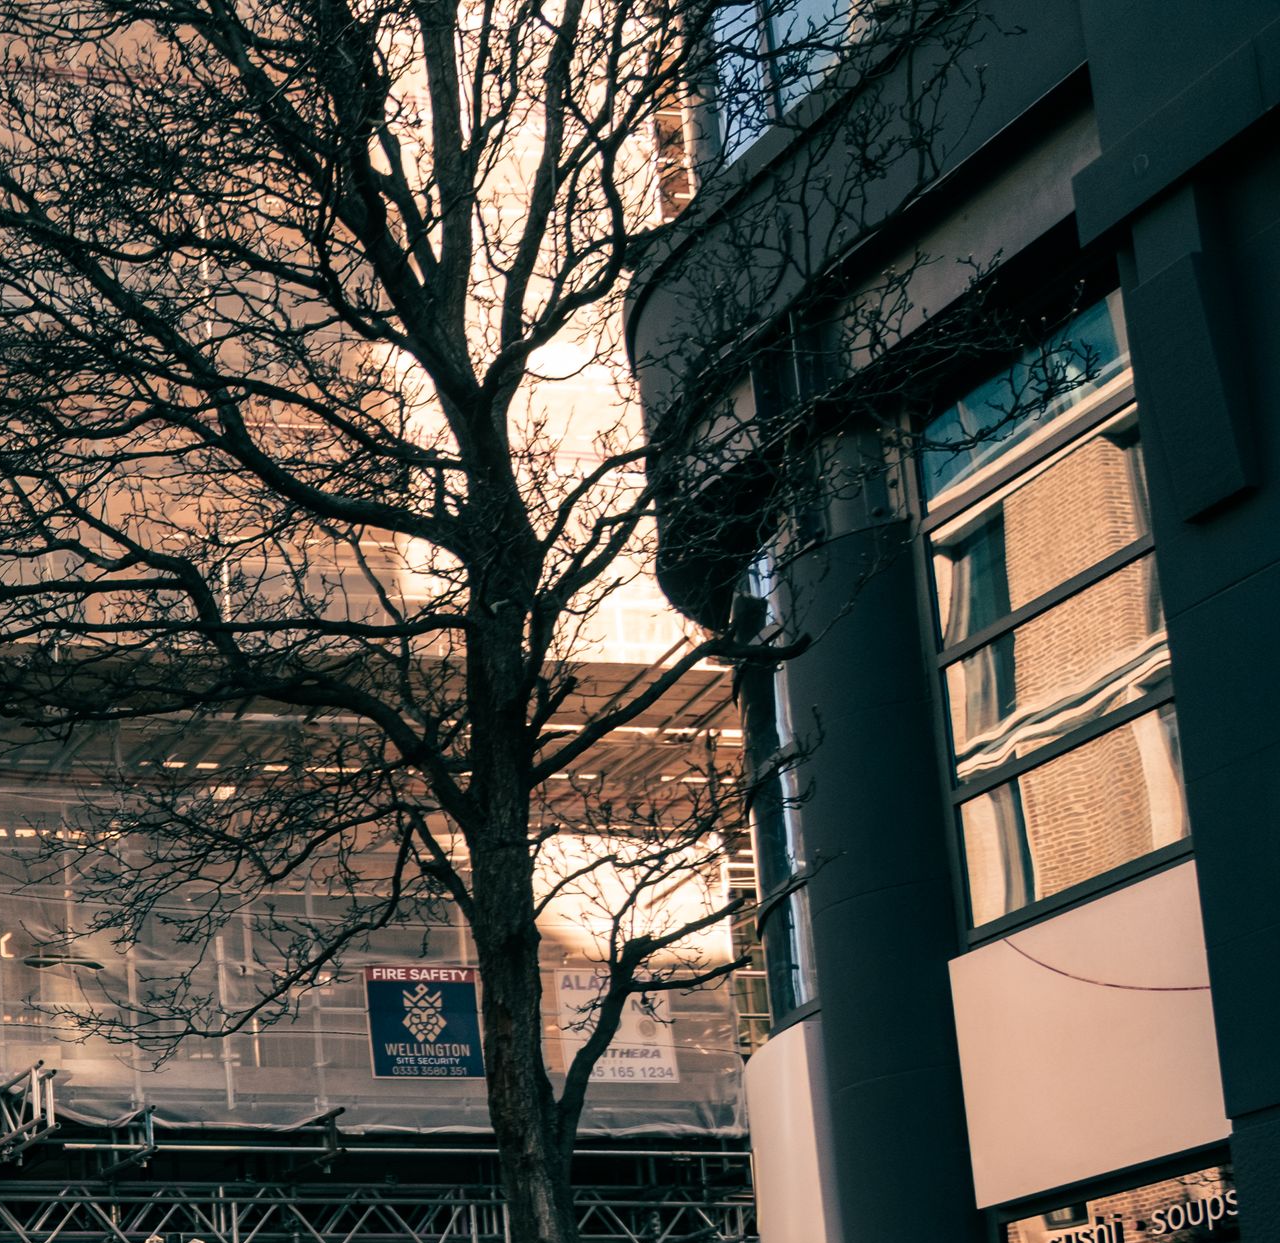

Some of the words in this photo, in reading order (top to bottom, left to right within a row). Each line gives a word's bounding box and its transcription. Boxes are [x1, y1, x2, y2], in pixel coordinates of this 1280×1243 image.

[372, 968, 406, 980] FIRE
[409, 969, 468, 981] SAFETY
[385, 1043, 471, 1057] WELLINGTON
[392, 1066, 419, 1075] 0333
[421, 1066, 447, 1075] 3580
[450, 1067, 468, 1076] 351
[610, 1066, 634, 1078] 165
[641, 1067, 673, 1078] 1234
[1151, 1189, 1239, 1235] soups
